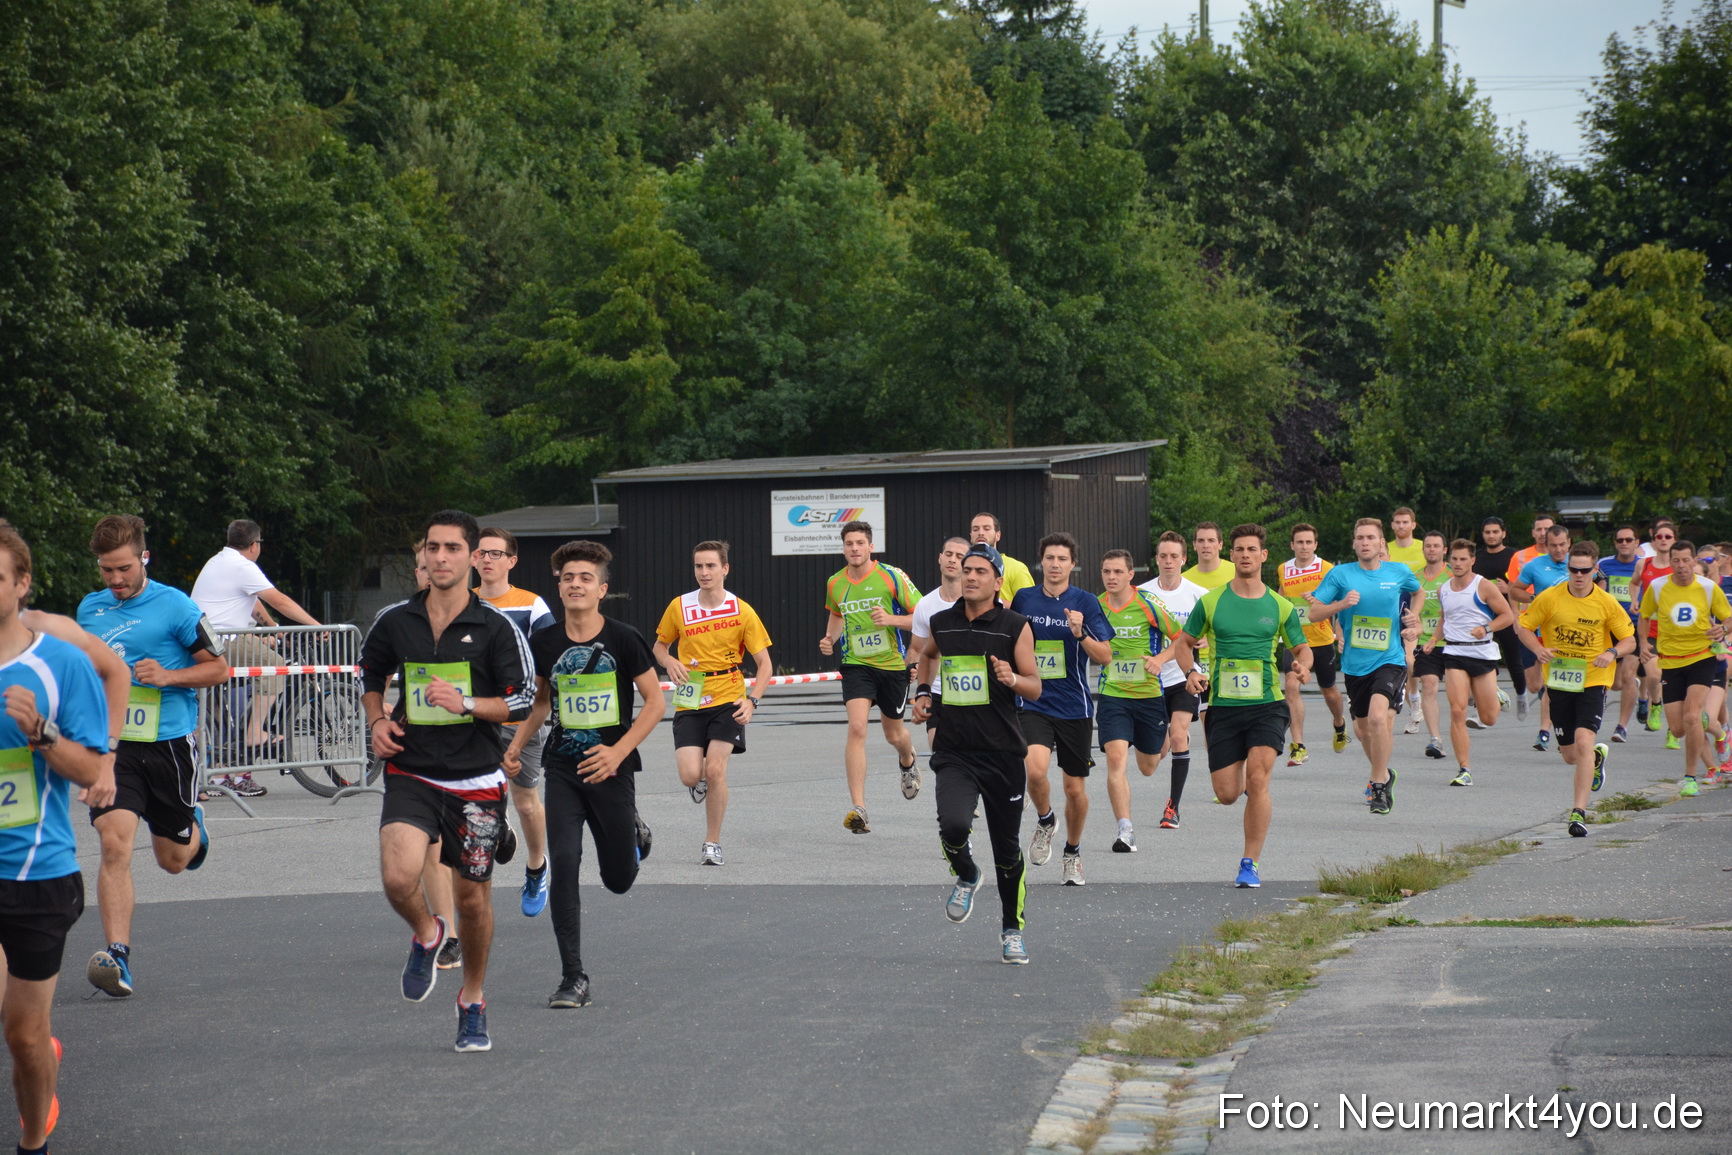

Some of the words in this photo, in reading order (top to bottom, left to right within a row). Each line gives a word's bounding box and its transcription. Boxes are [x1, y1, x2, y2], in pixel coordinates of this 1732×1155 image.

[773, 494, 825, 502] Kunsteisbahnen
[829, 493, 880, 501] Bandensysteme
[797, 509, 839, 523] AST
[784, 534, 833, 542] Eisbahntechnik
[1283, 579, 1301, 587] MAX
[1612, 586, 1629, 595] 165
[1677, 607, 1693, 622] B
[685, 624, 711, 637] MAX
[713, 618, 742, 631] BÖGL
[1051, 618, 1070, 628] POLE
[1427, 619, 1438, 628] 12
[1113, 626, 1142, 639] CK
[1355, 628, 1387, 642] 1076
[858, 634, 882, 648] 145
[1114, 662, 1137, 674] 147
[946, 675, 982, 692] 1660
[1232, 675, 1250, 688] 13
[1552, 670, 1583, 684] 1478
[565, 694, 612, 713] 1657
[0, 781, 18, 808] 2
